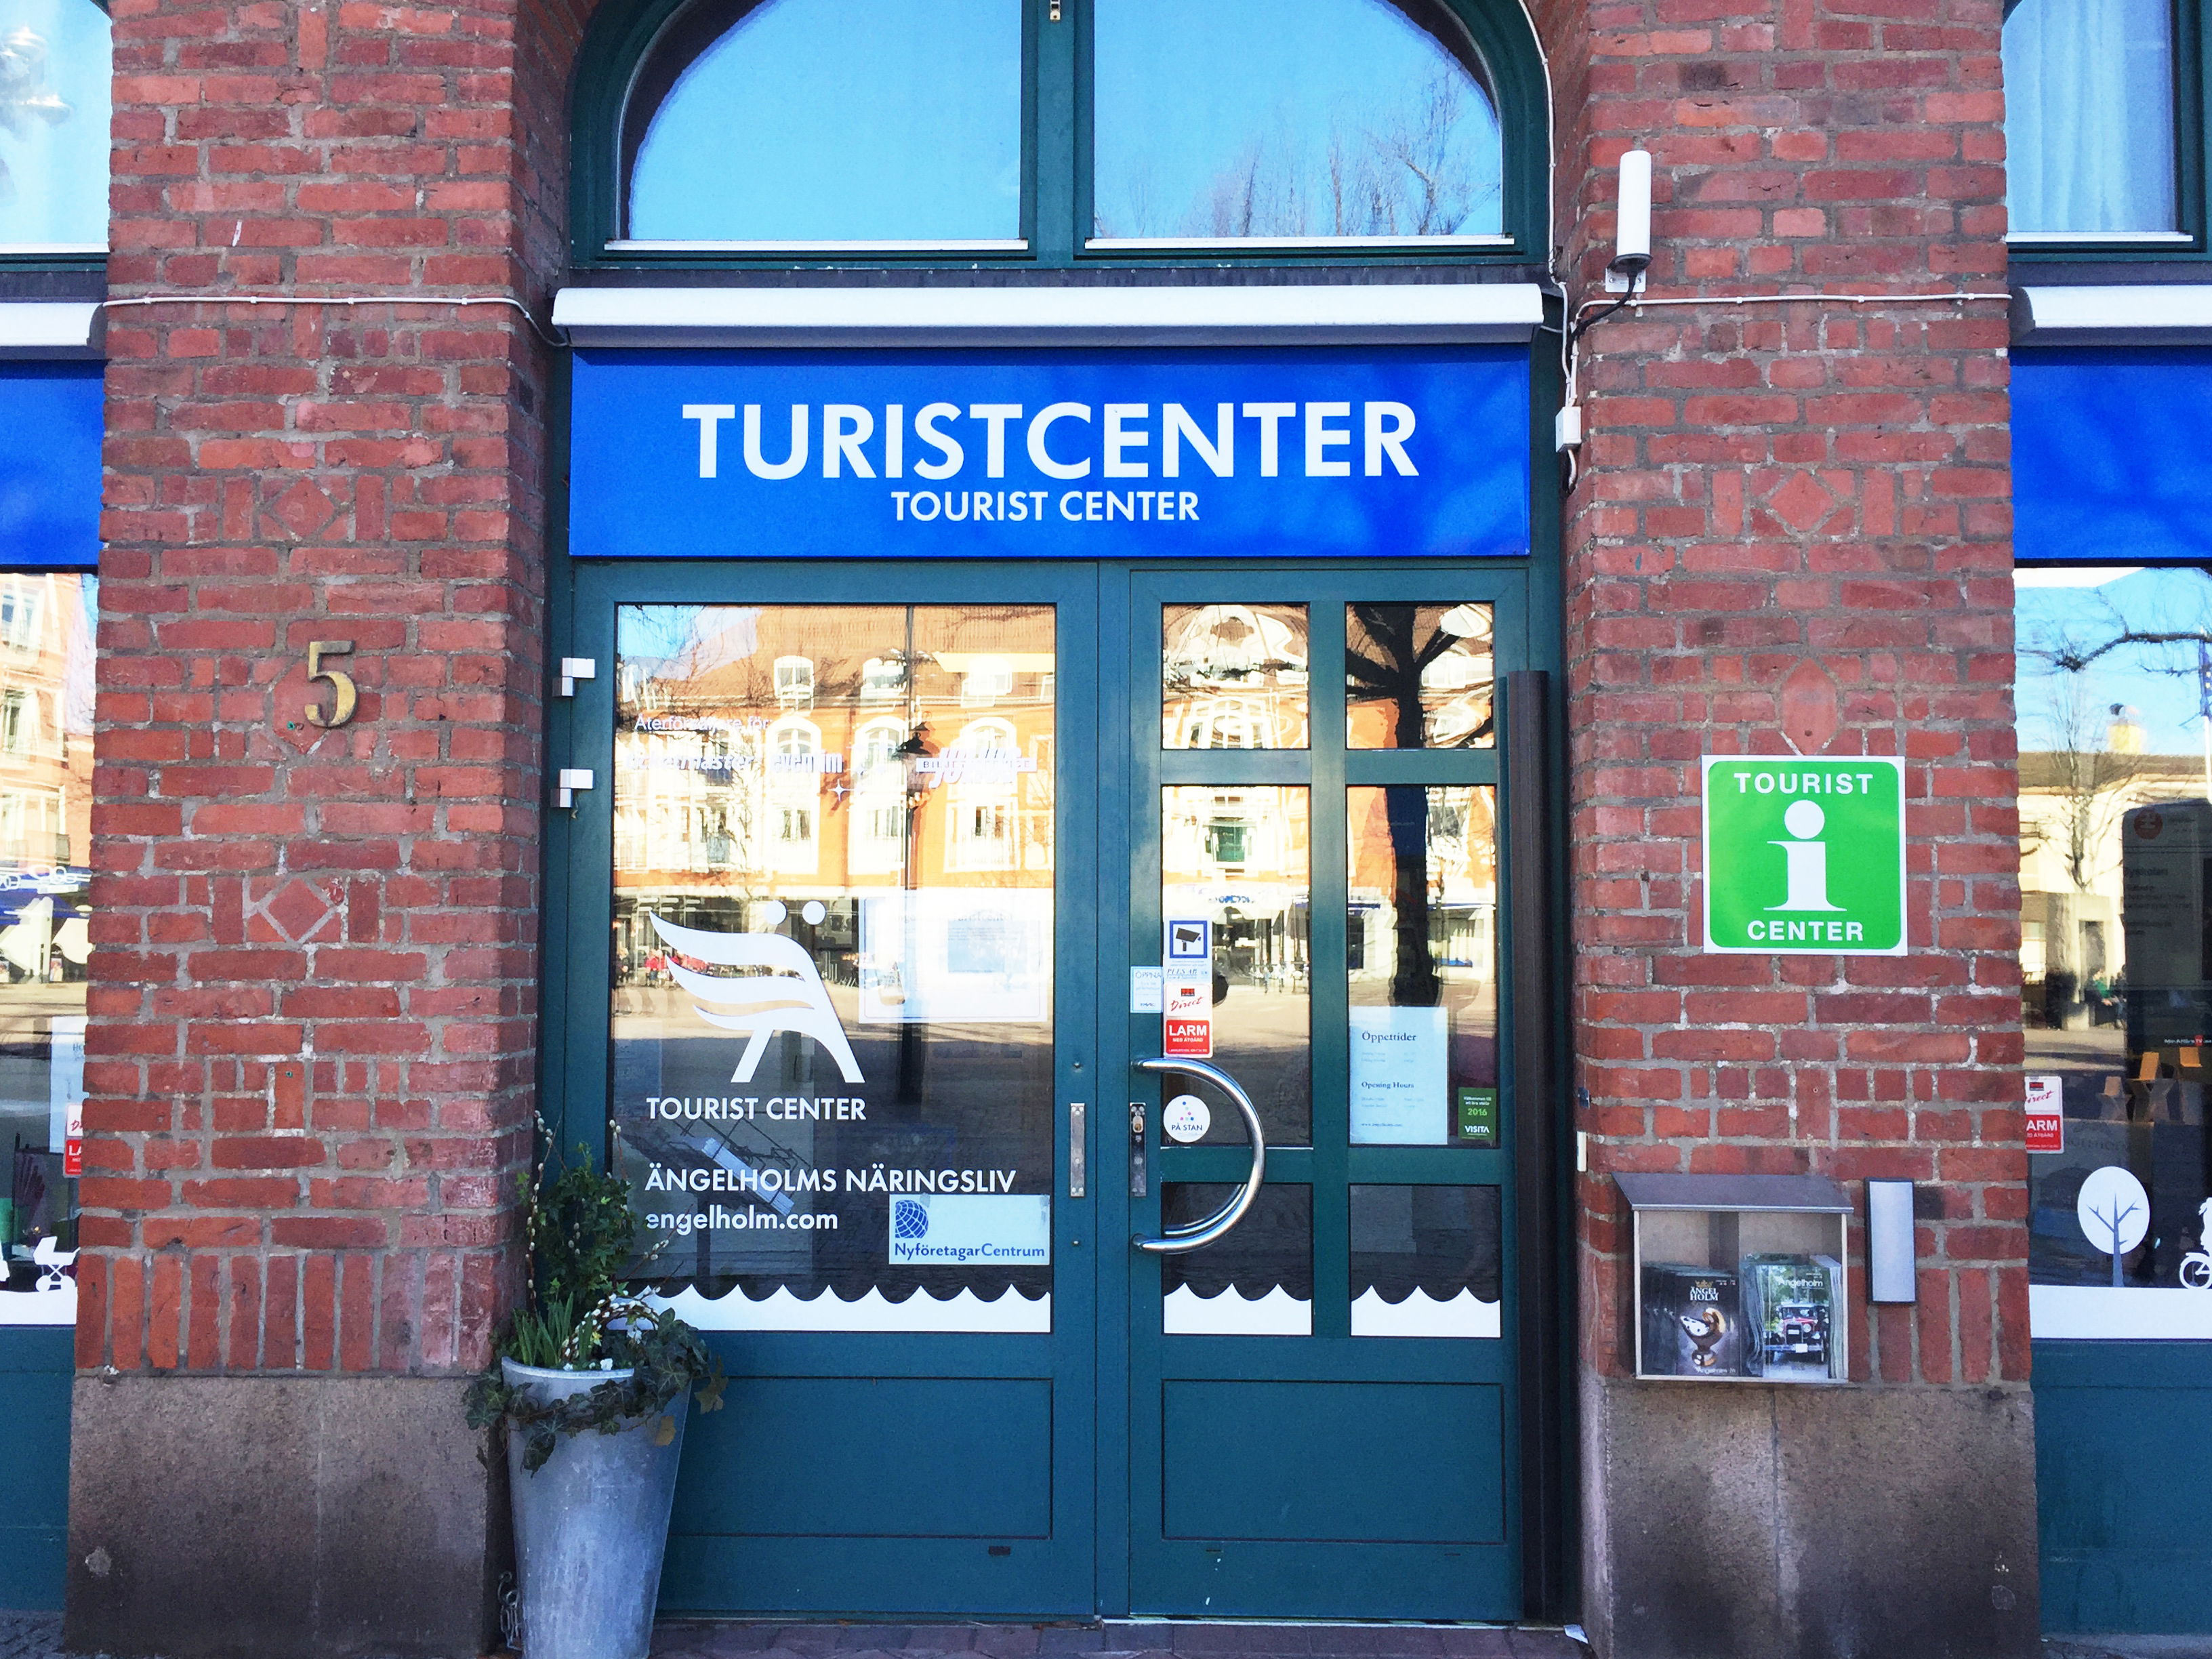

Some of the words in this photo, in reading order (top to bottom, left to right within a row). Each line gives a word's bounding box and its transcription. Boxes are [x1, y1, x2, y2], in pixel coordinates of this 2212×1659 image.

[682, 401, 1419, 480] TURISTCENTER
[890, 491, 1048, 521] TOURIST
[1059, 491, 1200, 521] CENTER
[304, 640, 356, 728] 5
[1734, 773, 1873, 794] TOURIST
[1747, 920, 1863, 941] CENTER
[1171, 997, 1204, 1011] Direct
[1168, 1025, 1207, 1036] LARM
[1361, 1030, 1417, 1043] Öppettider
[2026, 1090, 2054, 1103] irect
[647, 1097, 758, 1120] TOURIST
[766, 1097, 866, 1120] CENTER
[1467, 1108, 1488, 1116] 2016
[1171, 1122, 1181, 1130] PÅ
[1465, 1125, 1490, 1133] VISITA
[2026, 1120, 2057, 1131] ARM
[645, 1162, 837, 1191] ÄNGELHOLMS
[846, 1163, 1017, 1193] NÄRINGSLIV
[646, 1205, 838, 1235] engelholm.com
[895, 1243, 1045, 1261] NyföretagarCentrum
[1690, 1293, 1719, 1301] HOLM
